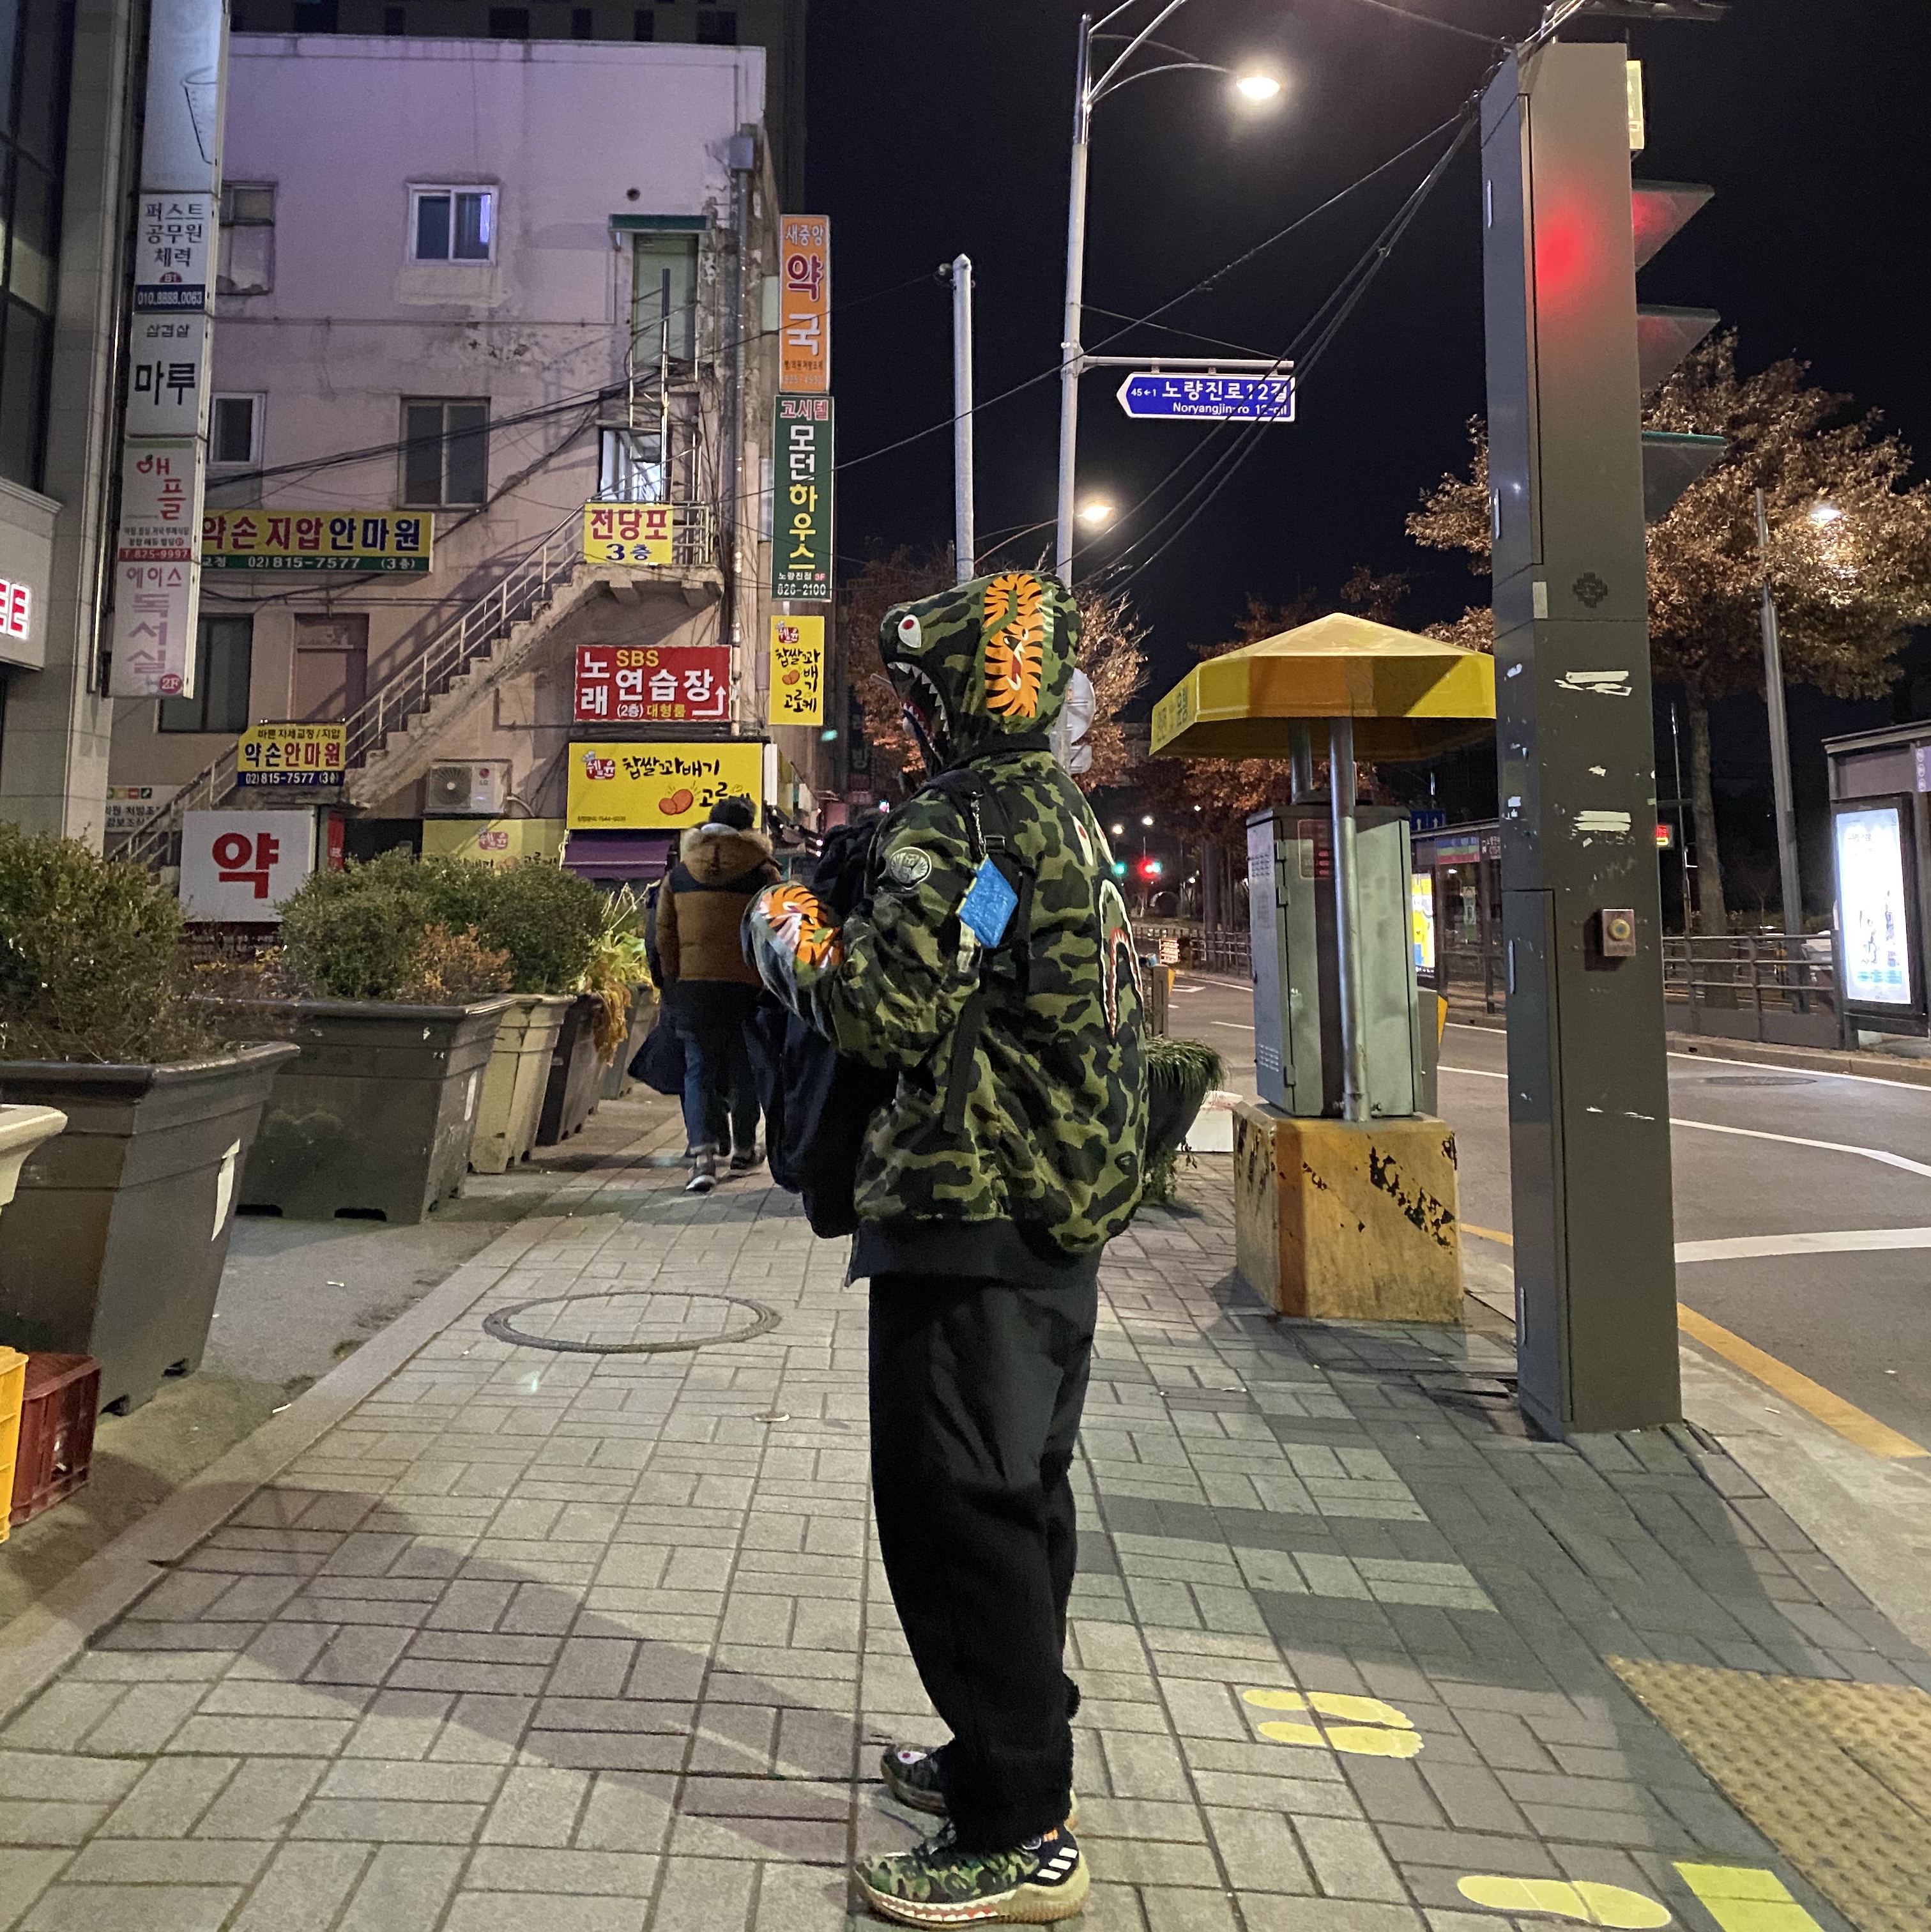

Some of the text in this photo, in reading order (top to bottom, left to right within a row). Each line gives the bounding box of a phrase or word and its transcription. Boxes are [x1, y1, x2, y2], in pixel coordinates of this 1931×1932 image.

[145, 202, 204, 222] 퍼스트
[145, 224, 203, 245] 공무원
[785, 224, 824, 247] 새중앙
[153, 247, 192, 268] 체력
[786, 253, 824, 356] 약국
[146, 323, 190, 338] 삼겹살
[134, 360, 196, 406] 마루
[1162, 380, 1287, 402] 노량진로12길
[780, 399, 829, 421] 고시텔
[1173, 402, 1249, 415] Noryangjin-ro
[590, 508, 668, 541] 전당포
[248, 557, 360, 569] 02)815-7577
[126, 566, 183, 588] 에이스
[128, 593, 170, 675] 독서실
[616, 649, 659, 667] SBS
[162, 677, 180, 691] 2F
[616, 703, 644, 718] (2층)
[246, 772, 315, 785] 02)815-7577
[622, 756, 720, 780] 찹쌀꽈배기
[699, 781, 751, 808] 고로
[126, 806, 160, 816] 처방조
[212, 832, 279, 899] 약
